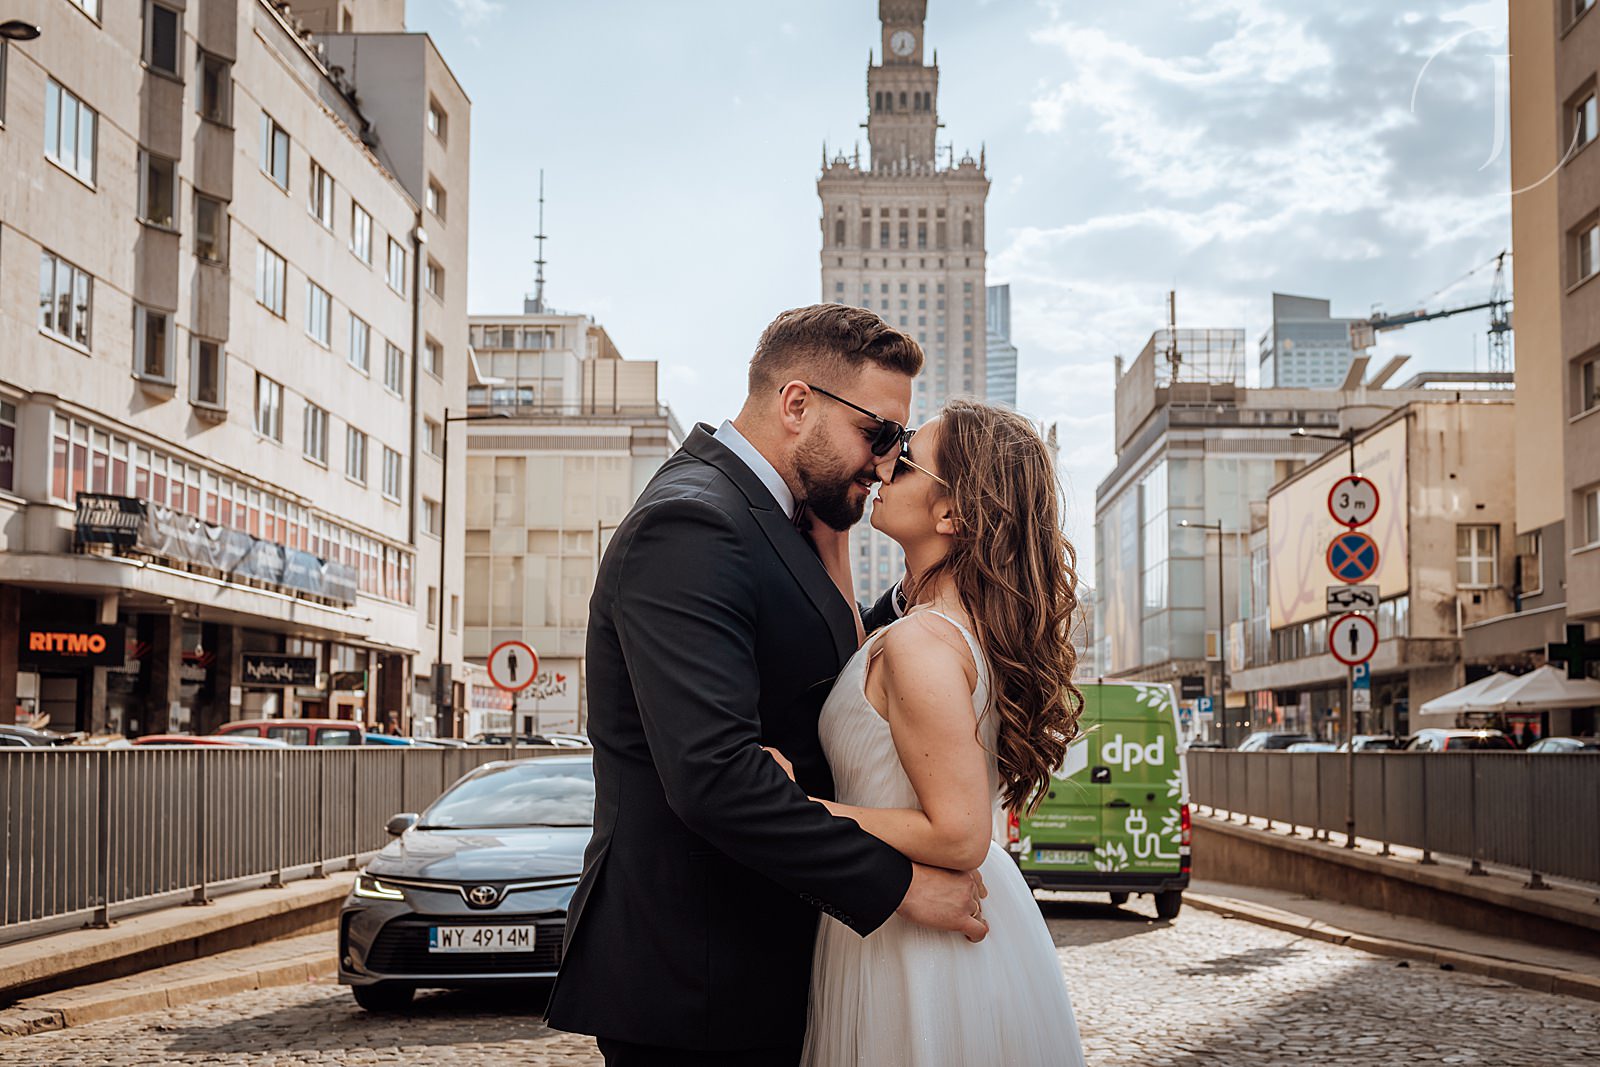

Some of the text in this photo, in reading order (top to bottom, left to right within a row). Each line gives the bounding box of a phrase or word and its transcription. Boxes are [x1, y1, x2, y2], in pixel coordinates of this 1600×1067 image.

[1339, 492, 1366, 510] 3 m
[30, 632, 106, 653] RITMO
[1353, 665, 1366, 682] P
[1200, 697, 1211, 711] P
[1102, 733, 1164, 772] dpd
[442, 928, 529, 947] WY 4914M
